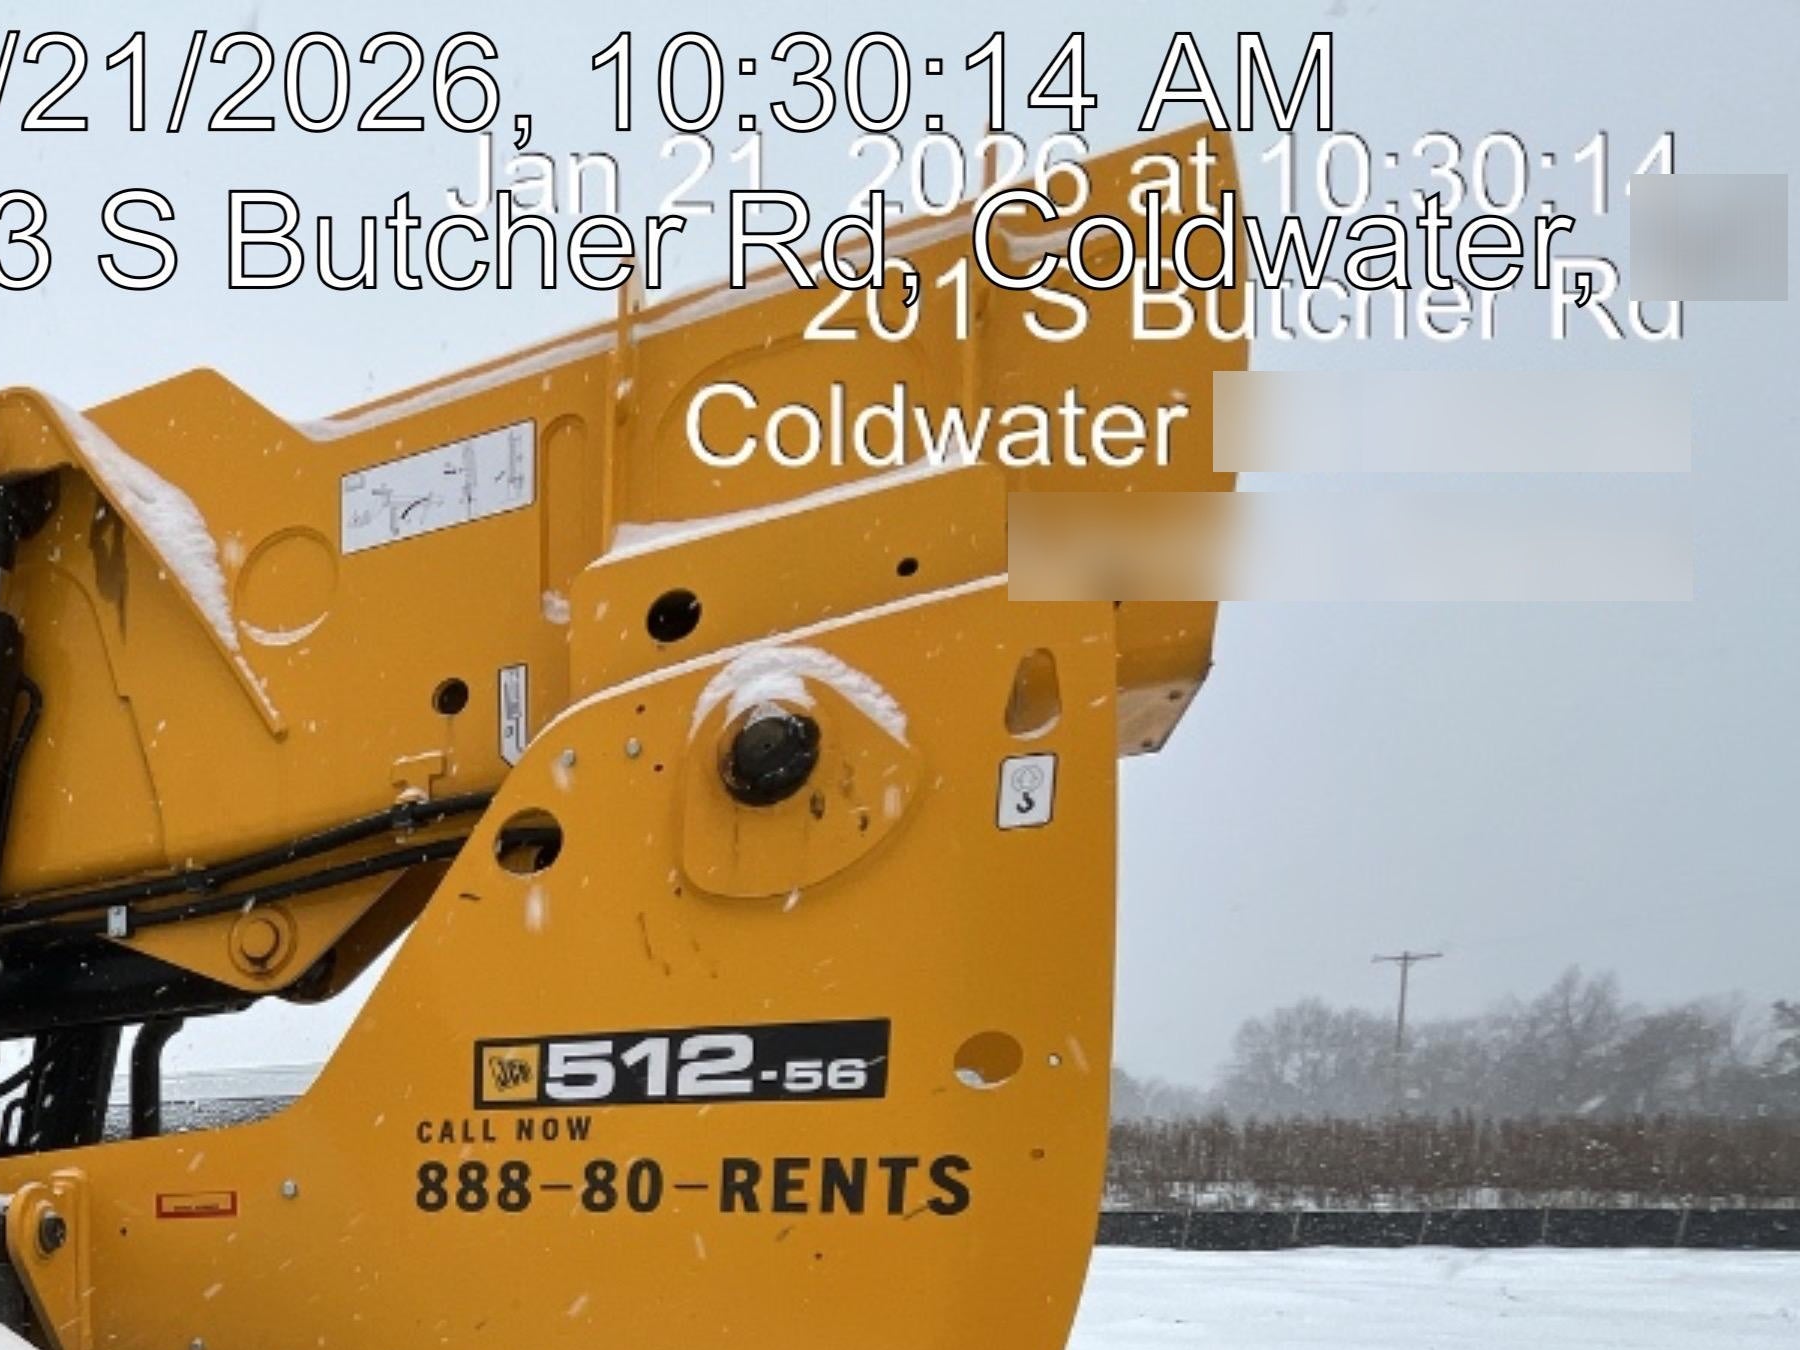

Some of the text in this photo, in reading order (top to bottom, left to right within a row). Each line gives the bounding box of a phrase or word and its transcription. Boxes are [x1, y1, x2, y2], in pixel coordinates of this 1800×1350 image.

[544, 1033, 870, 1100] 512-56
[417, 1115, 592, 1144] CALL NOW
[415, 1154, 973, 1217] 888-80-RENTS
